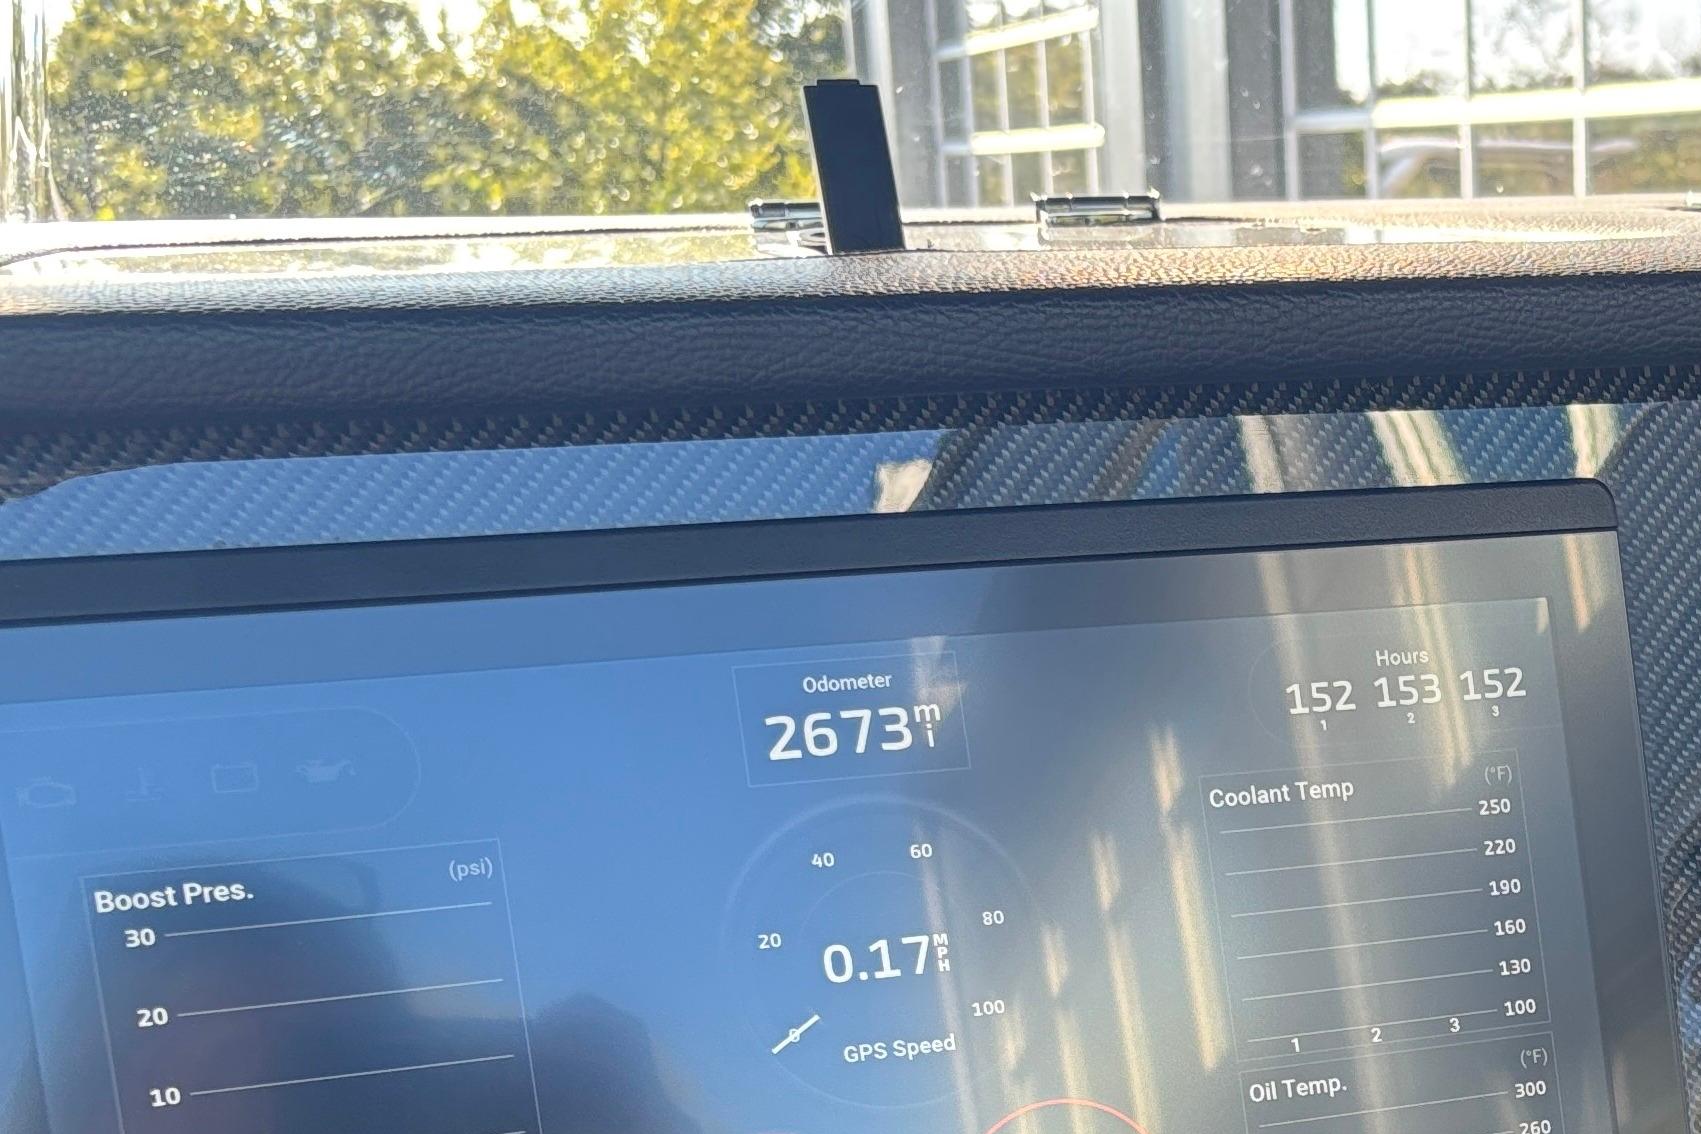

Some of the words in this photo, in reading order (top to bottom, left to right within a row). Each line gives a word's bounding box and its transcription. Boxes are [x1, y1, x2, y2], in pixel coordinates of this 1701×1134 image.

[1375, 649, 1429, 667] Hours
[802, 672, 893, 694] Odometer
[1286, 680, 1356, 715] 152
[1373, 673, 1441, 708] 153
[1459, 667, 1527, 701] 152
[765, 706, 913, 762] 2673
[1209, 782, 1290, 808] Coolant
[1296, 780, 1354, 801] Temp
[448, 857, 493, 882] (psi)
[95, 883, 177, 913] Boost
[183, 880, 254, 905] Pres.
[823, 936, 932, 985] 0.17
[843, 1042, 888, 1063] GPS
[893, 1033, 956, 1062] Speed
[1249, 1080, 1277, 1103] Oil
[1282, 1076, 1347, 1098] Temp.
